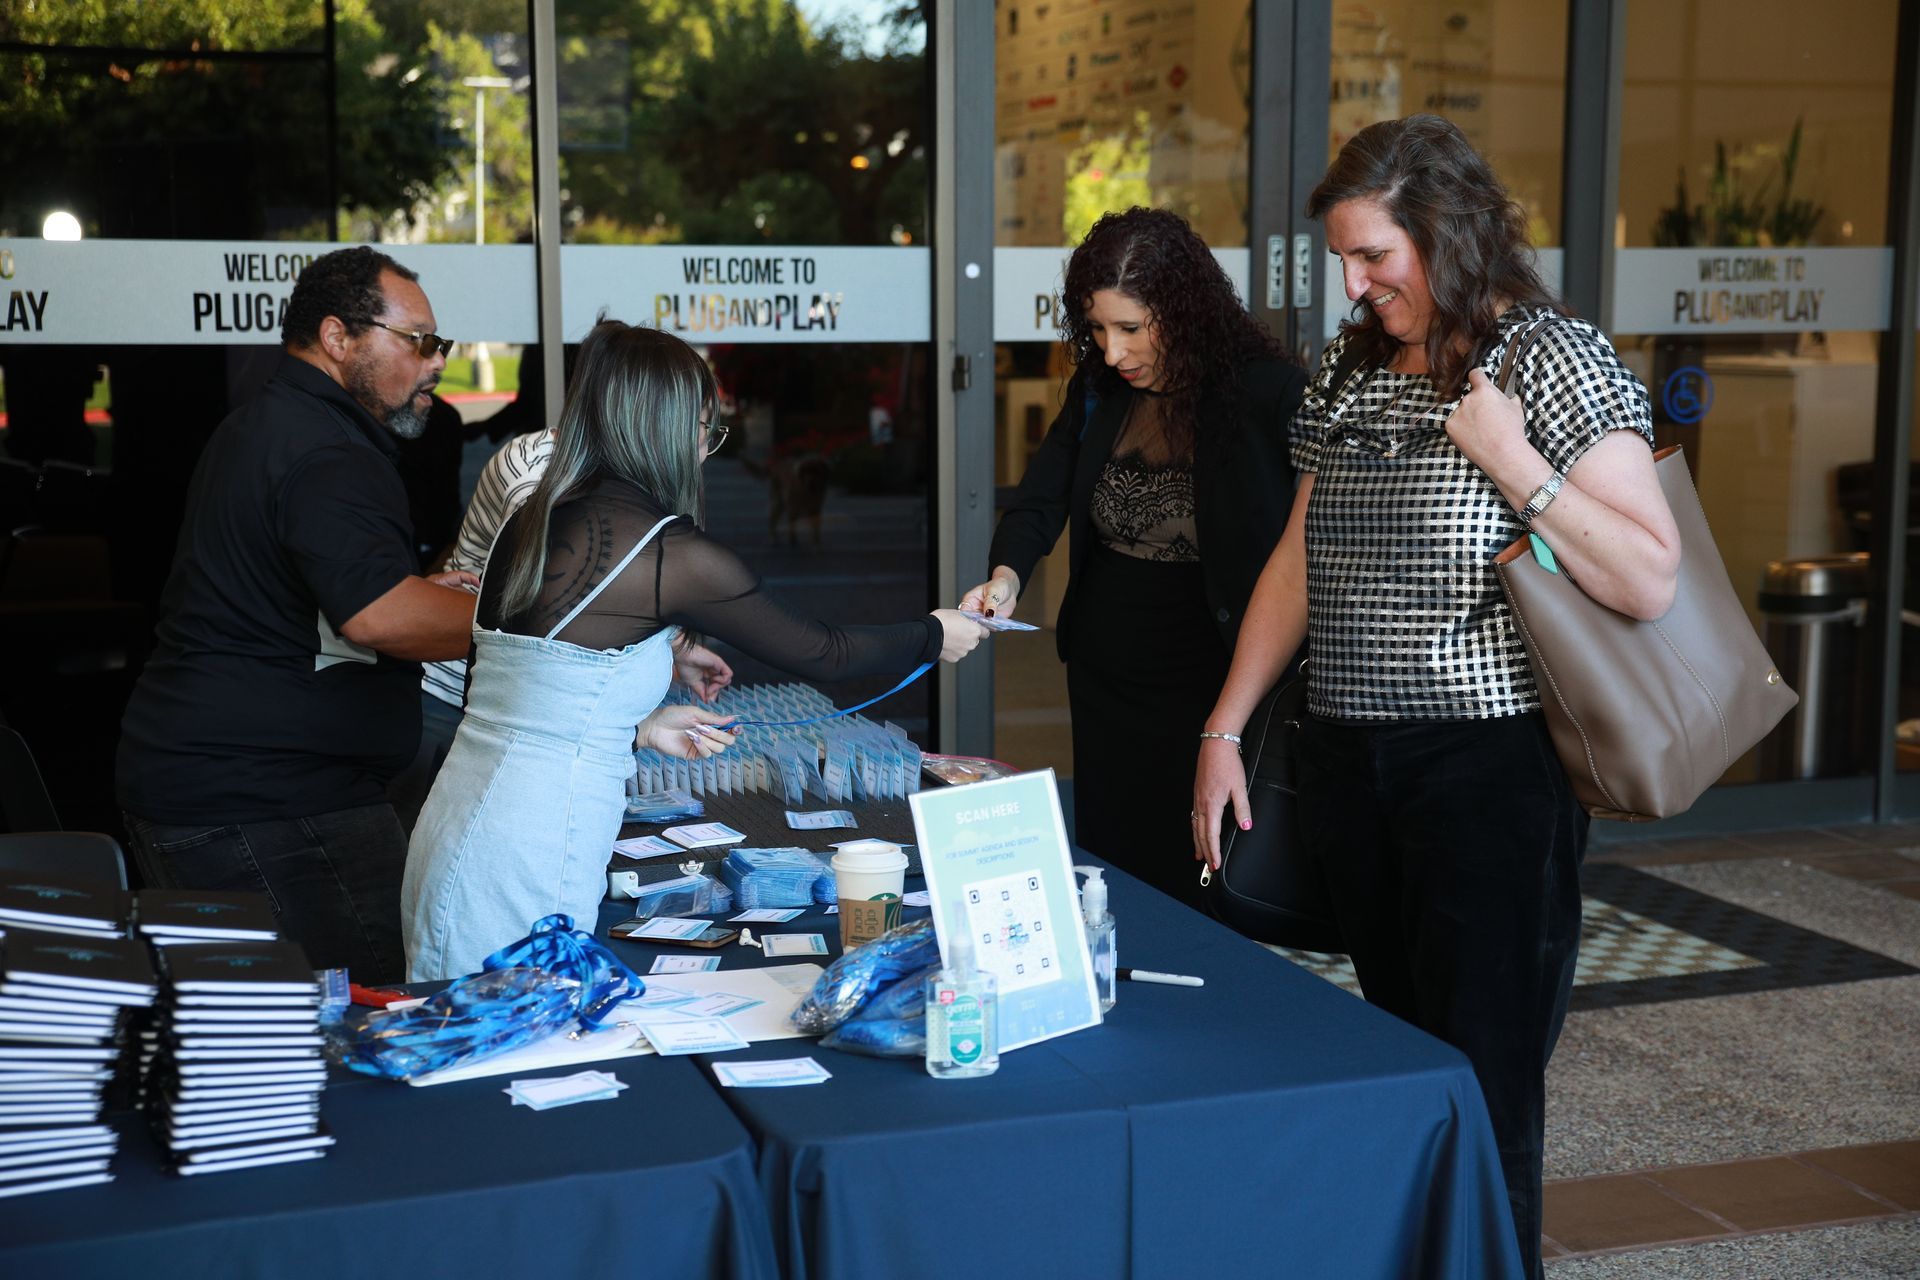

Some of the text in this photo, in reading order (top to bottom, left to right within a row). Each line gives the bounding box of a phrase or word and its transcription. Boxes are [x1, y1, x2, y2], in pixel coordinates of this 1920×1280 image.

[224, 253, 313, 283] WELCO
[683, 257, 816, 285] WELCOME TO
[1698, 256, 1806, 283] WELCOME TO
[655, 292, 845, 333] PLUGANDPLAY
[1674, 289, 1825, 325] PLUGANDPLAY
[955, 801, 1021, 825] SCAN HERE
